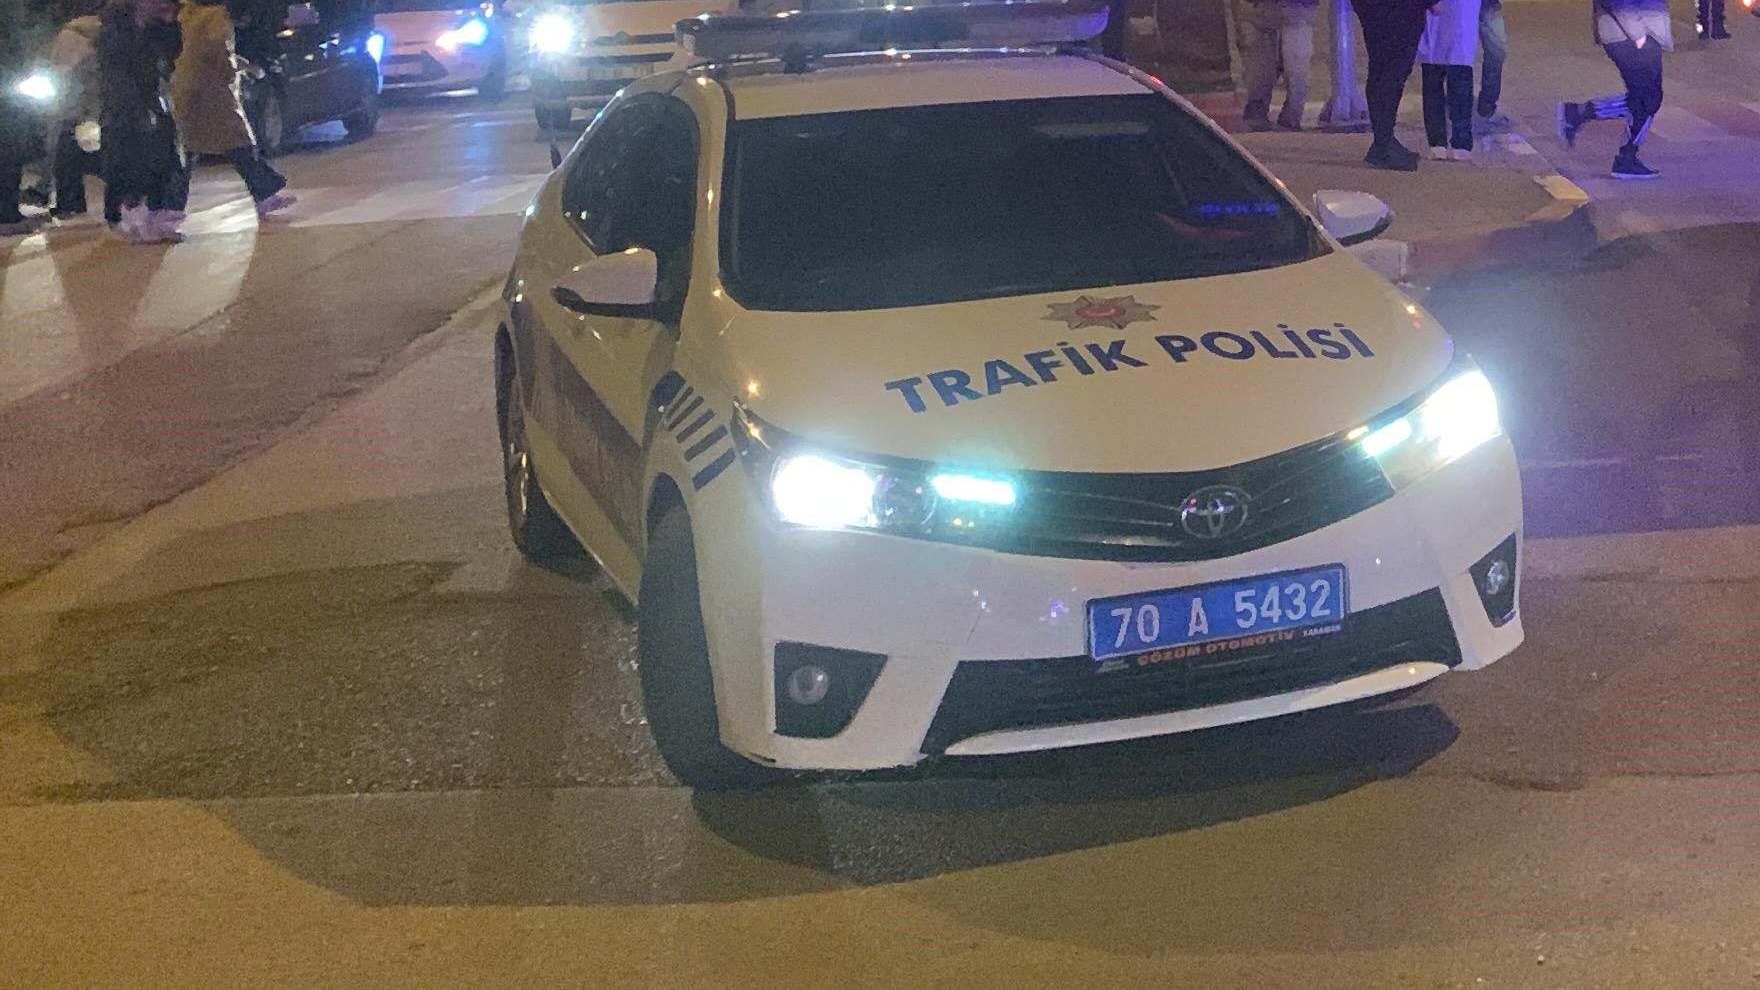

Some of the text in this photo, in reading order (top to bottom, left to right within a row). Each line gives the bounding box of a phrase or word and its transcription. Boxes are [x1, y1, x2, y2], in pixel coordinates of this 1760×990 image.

[884, 322, 1376, 414] TRAFİK POLİSİ
[1110, 578, 1331, 649] 70 A 5432
[1205, 630, 1296, 655] OTOMOTİV
